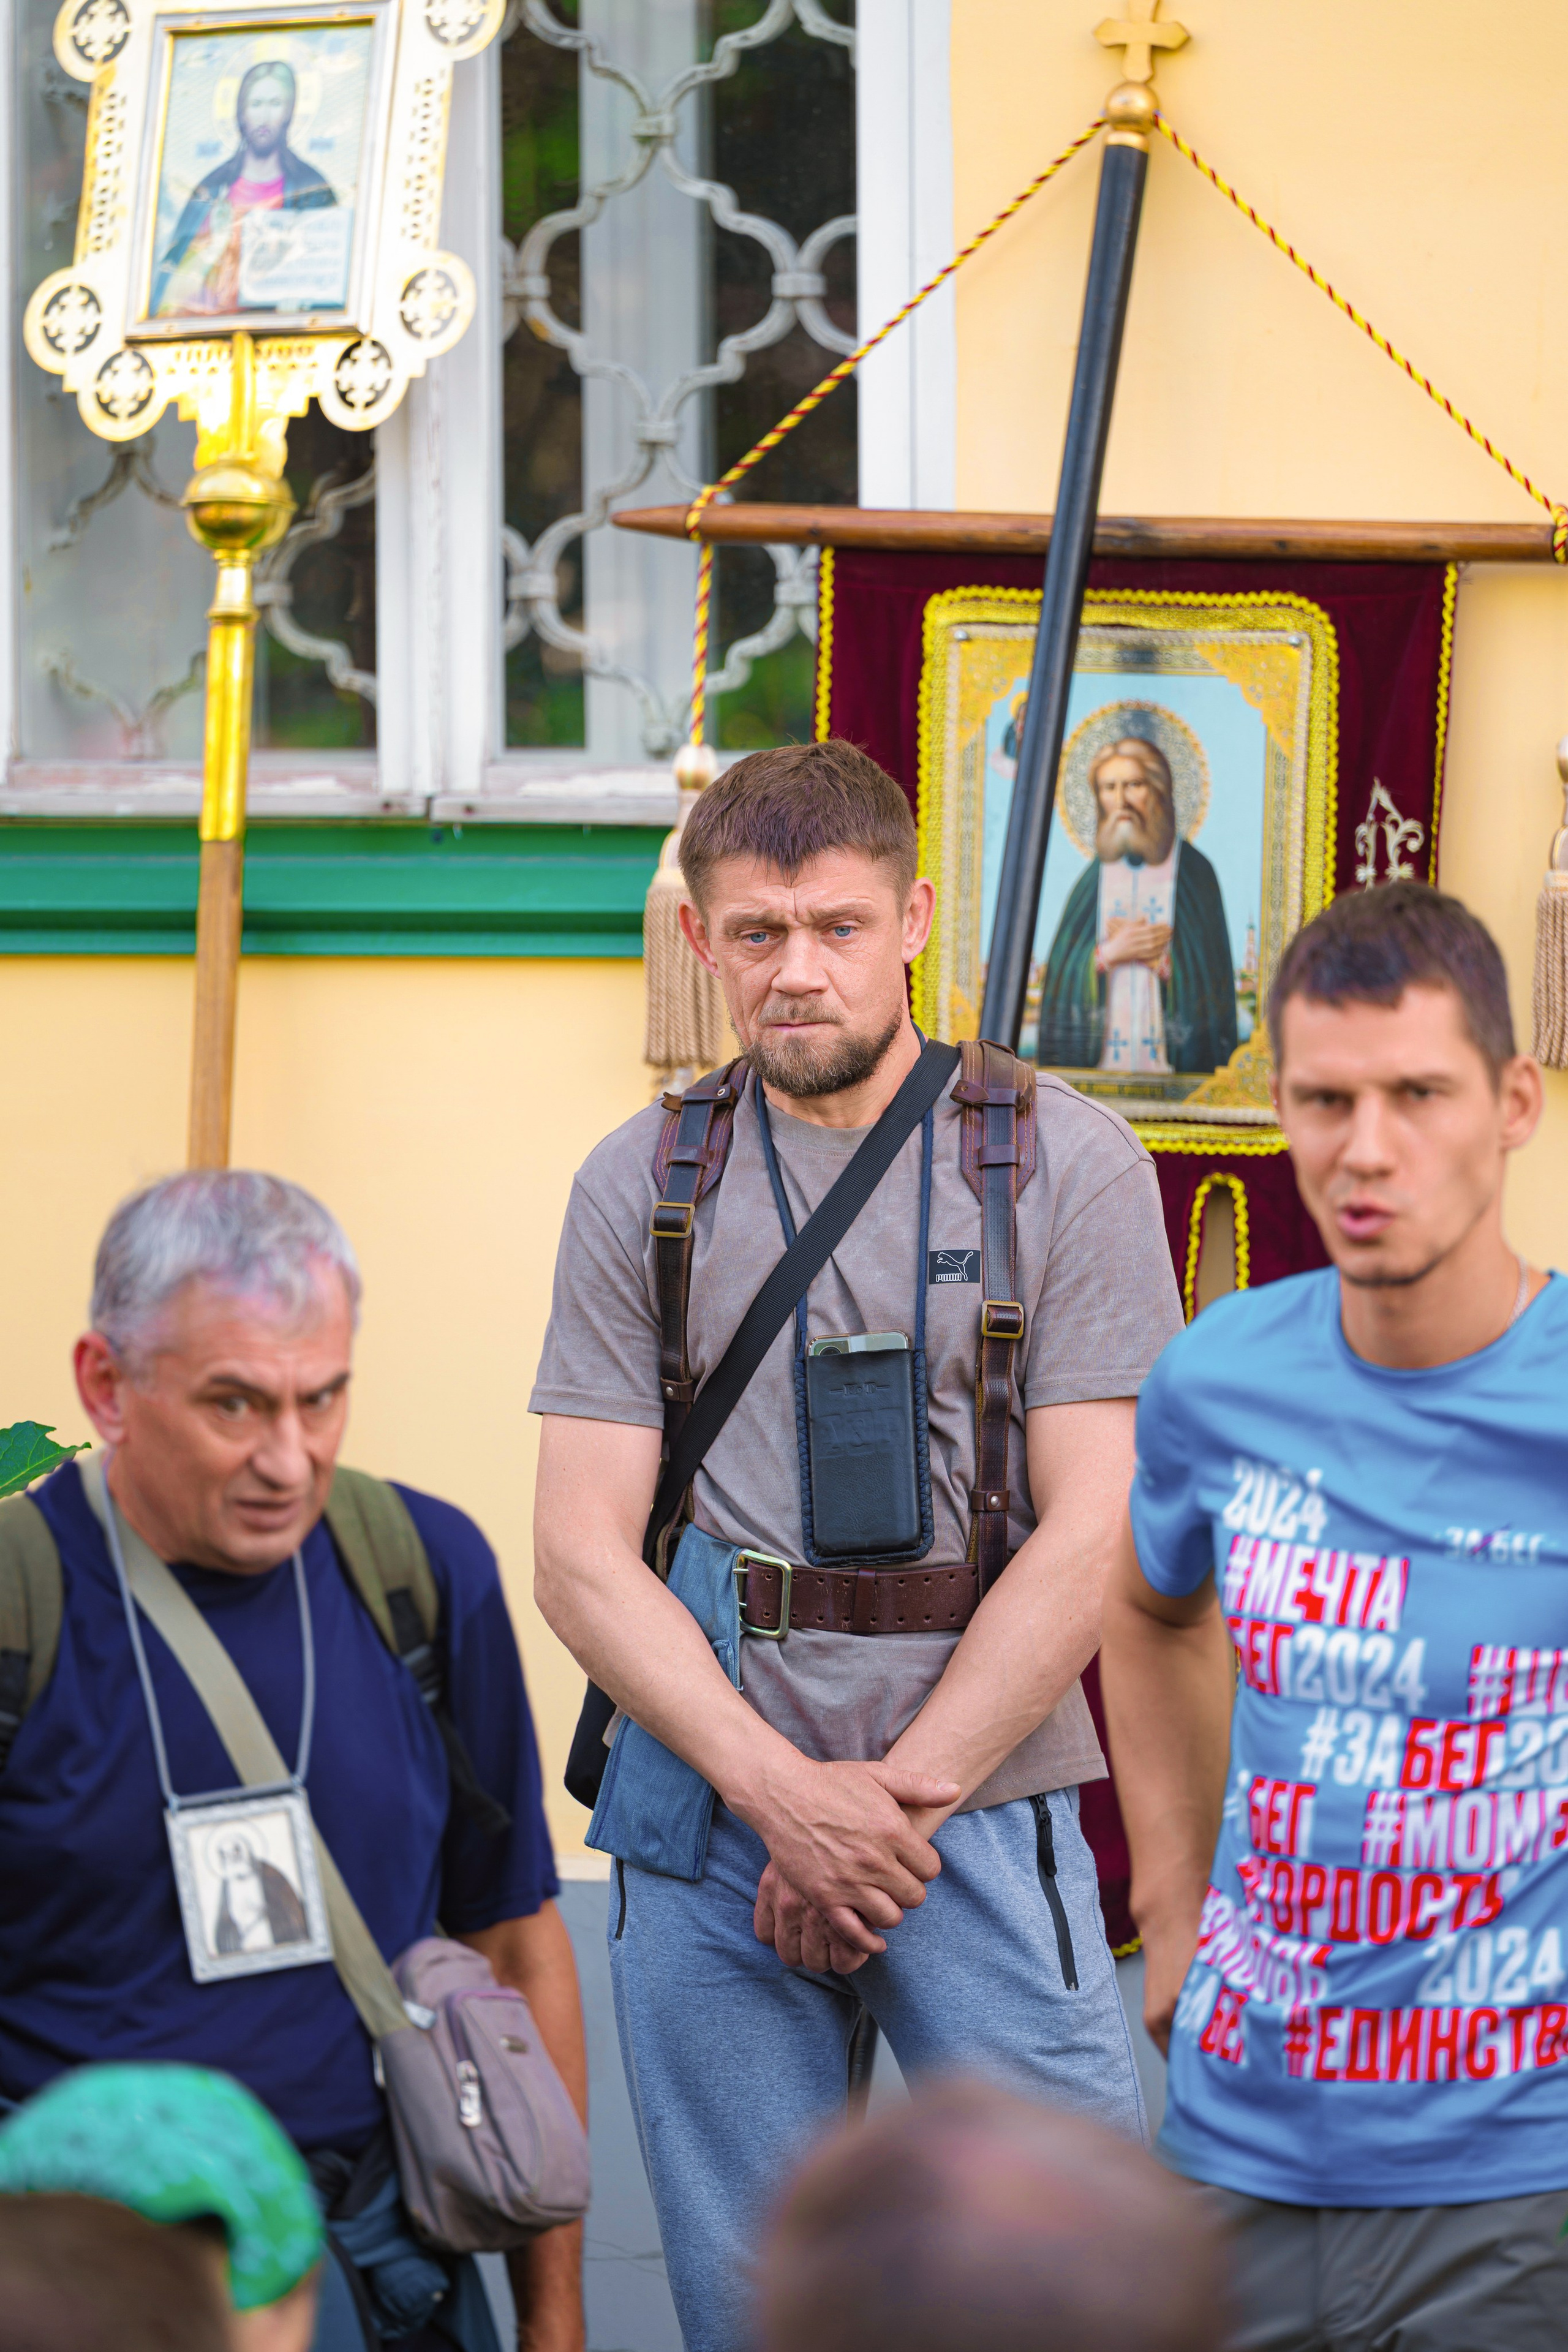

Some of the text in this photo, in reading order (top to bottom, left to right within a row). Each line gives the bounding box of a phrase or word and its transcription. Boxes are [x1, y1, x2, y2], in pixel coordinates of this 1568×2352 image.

[935, 1273, 962, 1283] PUMA
[1224, 1534, 1410, 1633] #МЕЧТА
[1416, 1926, 1566, 2004] 2024
[1284, 2003, 1568, 2082] #ЕДИНСТВ
